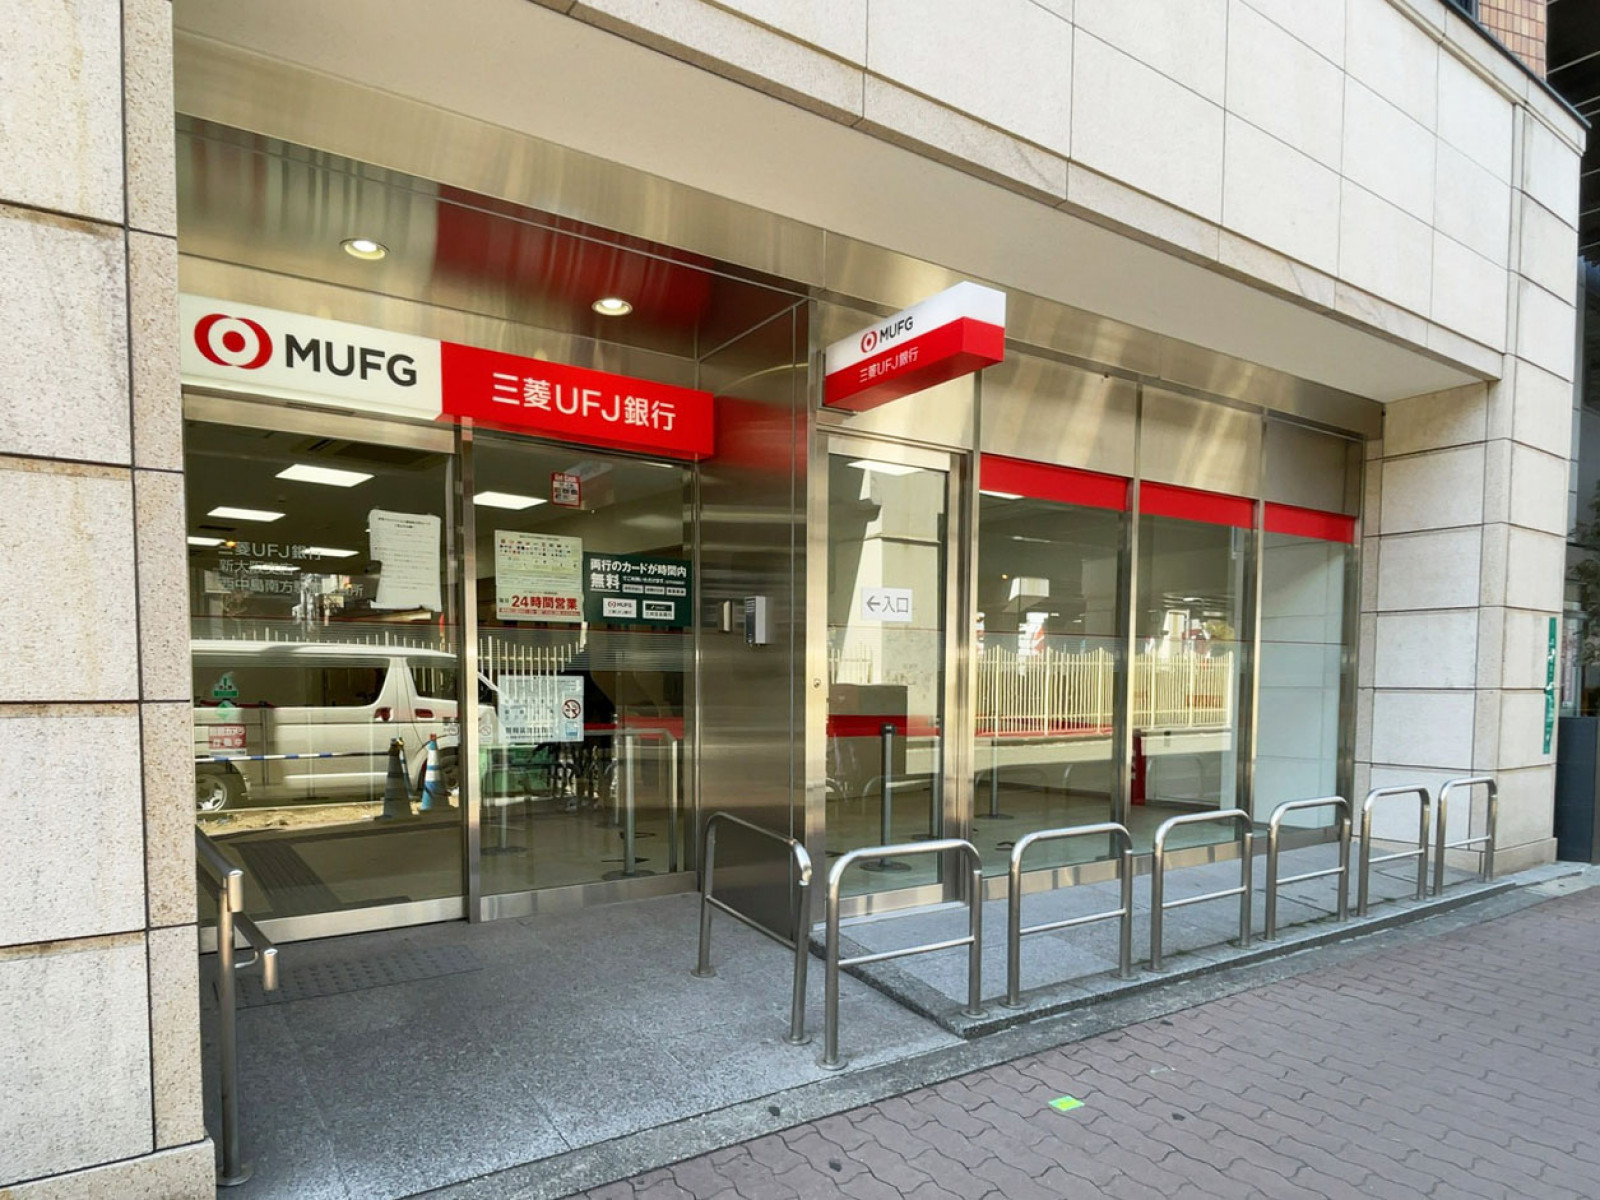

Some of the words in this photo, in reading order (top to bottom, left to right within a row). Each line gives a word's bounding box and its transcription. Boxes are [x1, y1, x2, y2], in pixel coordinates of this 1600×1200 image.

[879, 315, 914, 343] MUFG
[284, 333, 417, 387] MUFG
[858, 346, 919, 383] 三菱UFJ銀行
[492, 372, 676, 432] 三菱UFJ銀行
[589, 558, 687, 578] 両行のカードが時間内
[589, 572, 621, 590] 無料
[511, 595, 578, 611] 24時間営業
[881, 595, 909, 613] 入口
